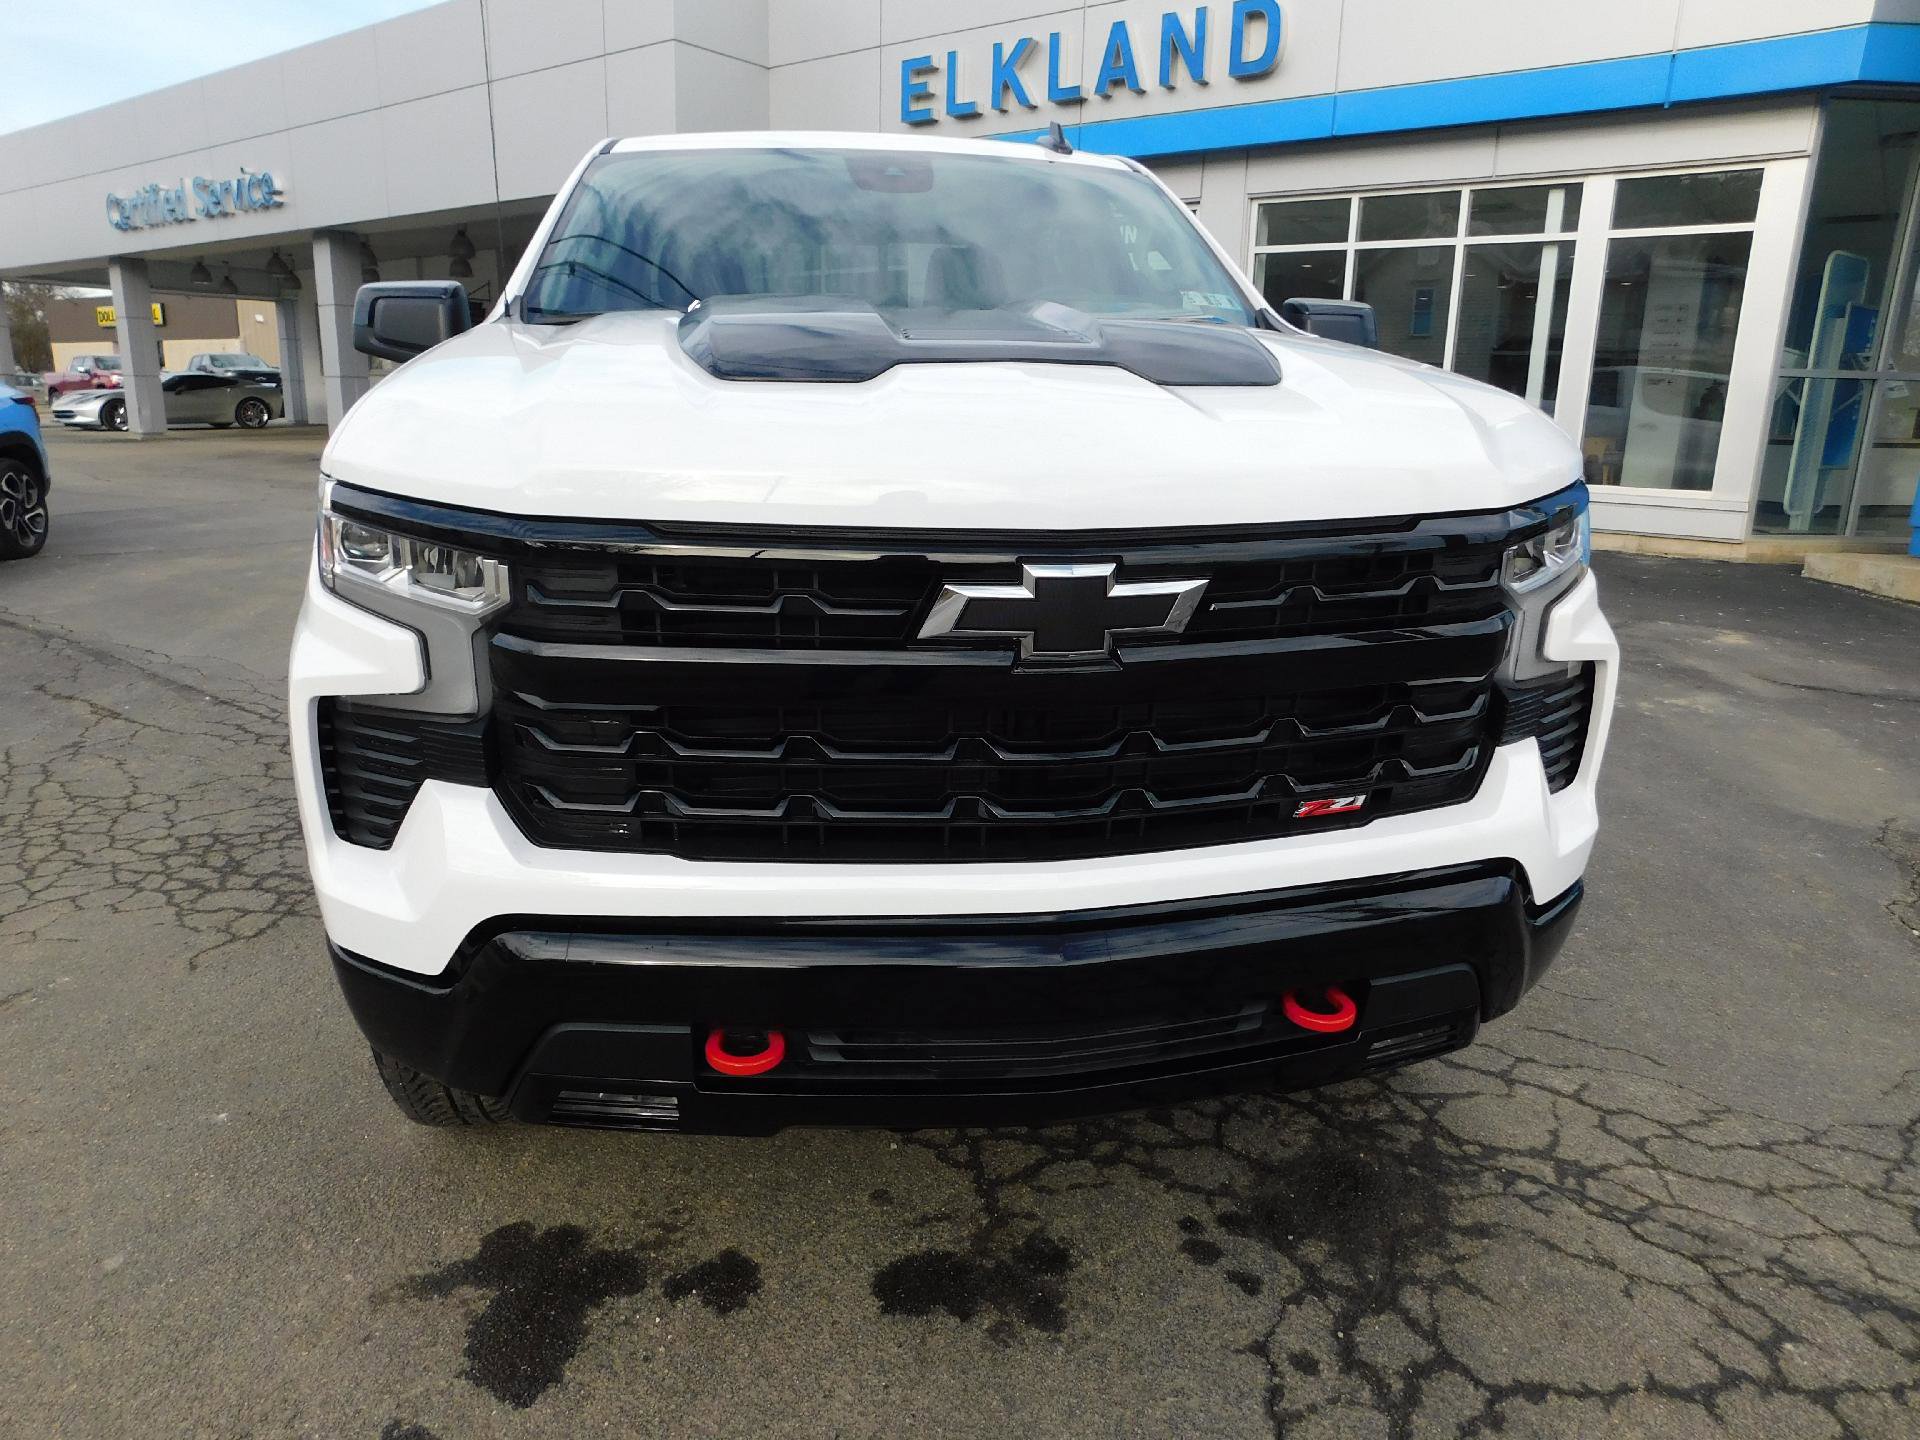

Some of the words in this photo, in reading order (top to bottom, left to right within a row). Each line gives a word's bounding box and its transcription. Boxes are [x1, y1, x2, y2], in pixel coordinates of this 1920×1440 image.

[901, 0, 1283, 125] ELKLAND
[106, 177, 192, 231] Certified
[192, 167, 281, 218] Service
[98, 310, 116, 323] DOLL
[1292, 795, 1366, 818] Z71
